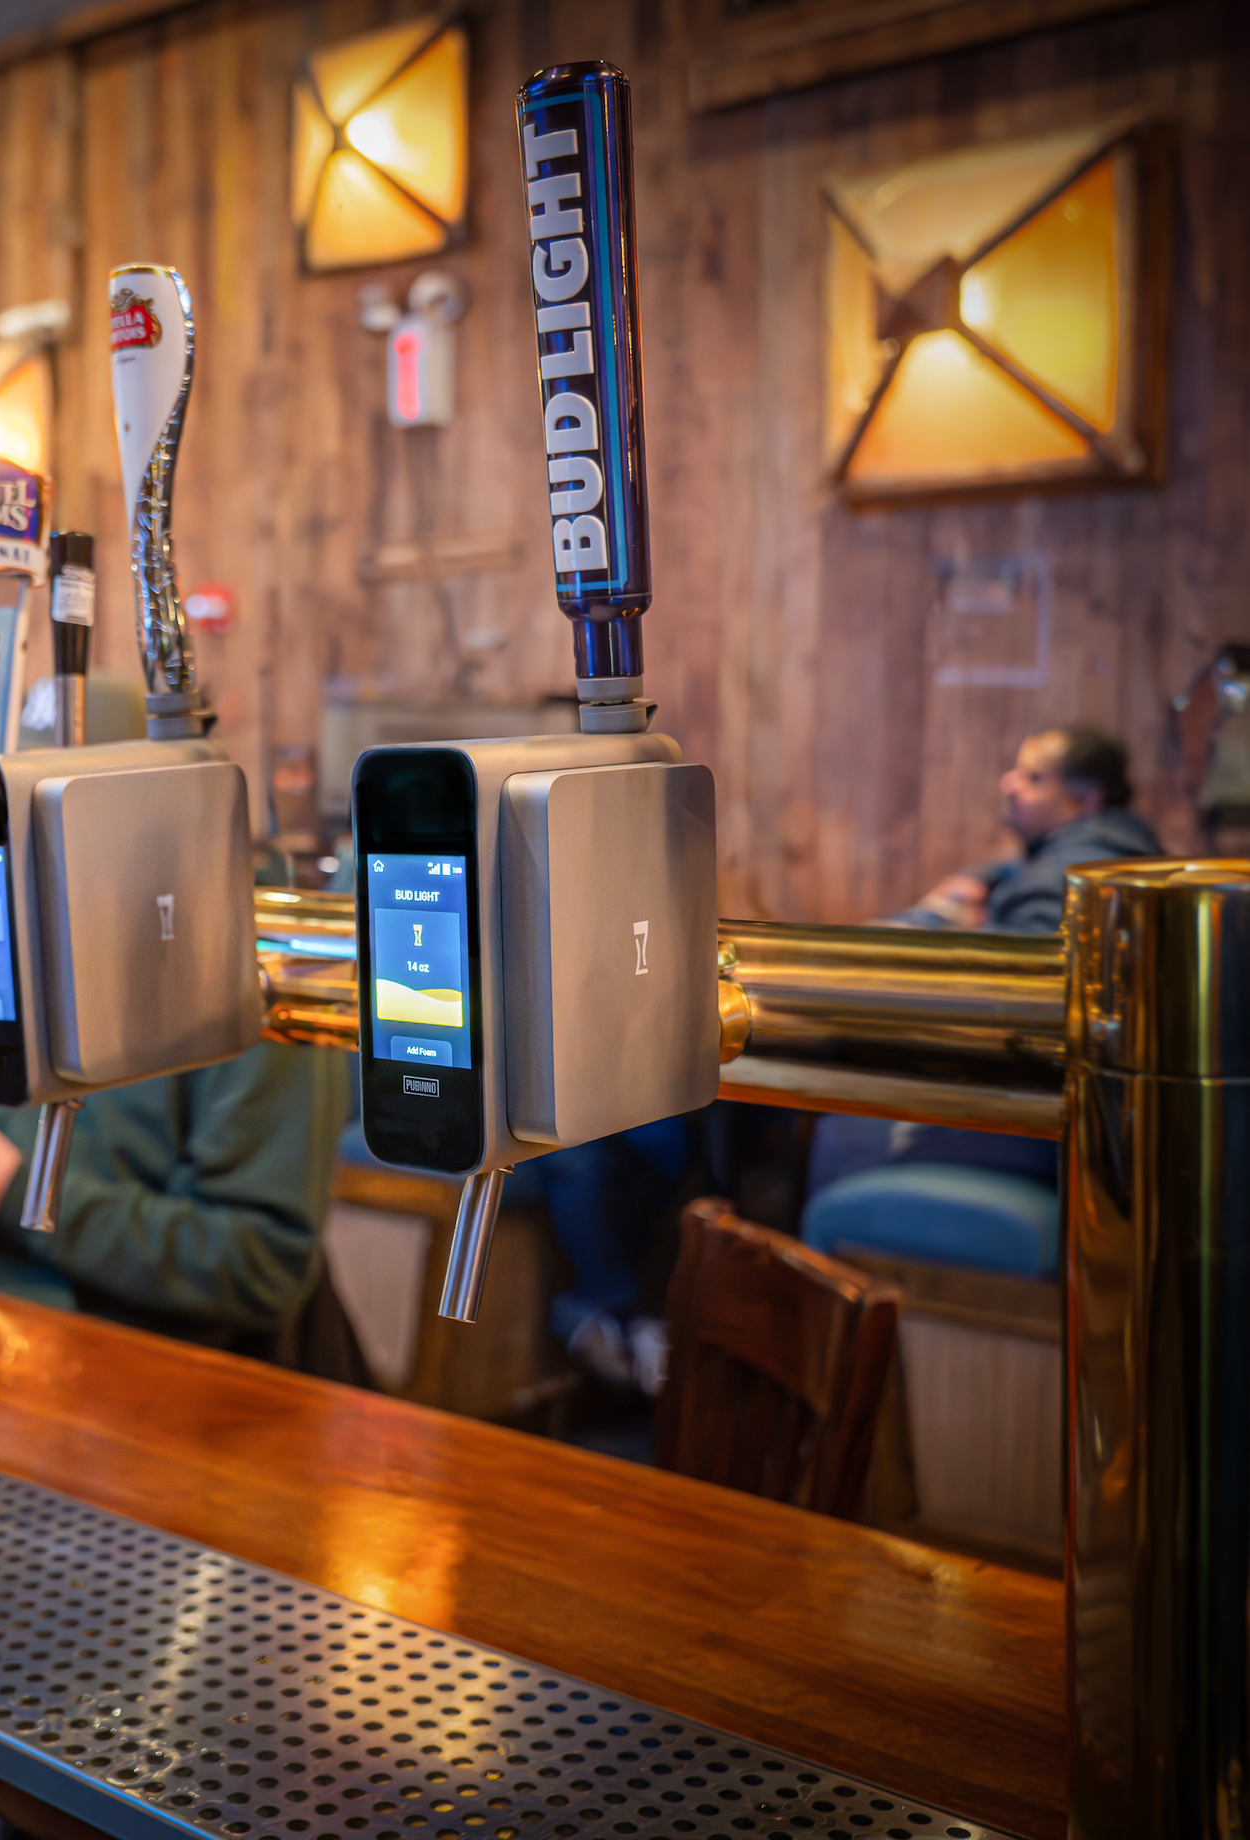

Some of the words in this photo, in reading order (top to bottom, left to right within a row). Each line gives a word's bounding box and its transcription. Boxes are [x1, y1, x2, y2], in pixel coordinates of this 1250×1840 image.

[523, 123, 595, 380] LIGHT
[545, 391, 608, 573] BUD
[395, 889, 413, 901] BUD
[414, 891, 440, 902] LIGHT
[406, 960, 418, 972] 14
[418, 964, 430, 973] oz
[406, 1046, 419, 1055] Add
[419, 1047, 437, 1057] Foam
[405, 1078, 437, 1094] PUBINNO
